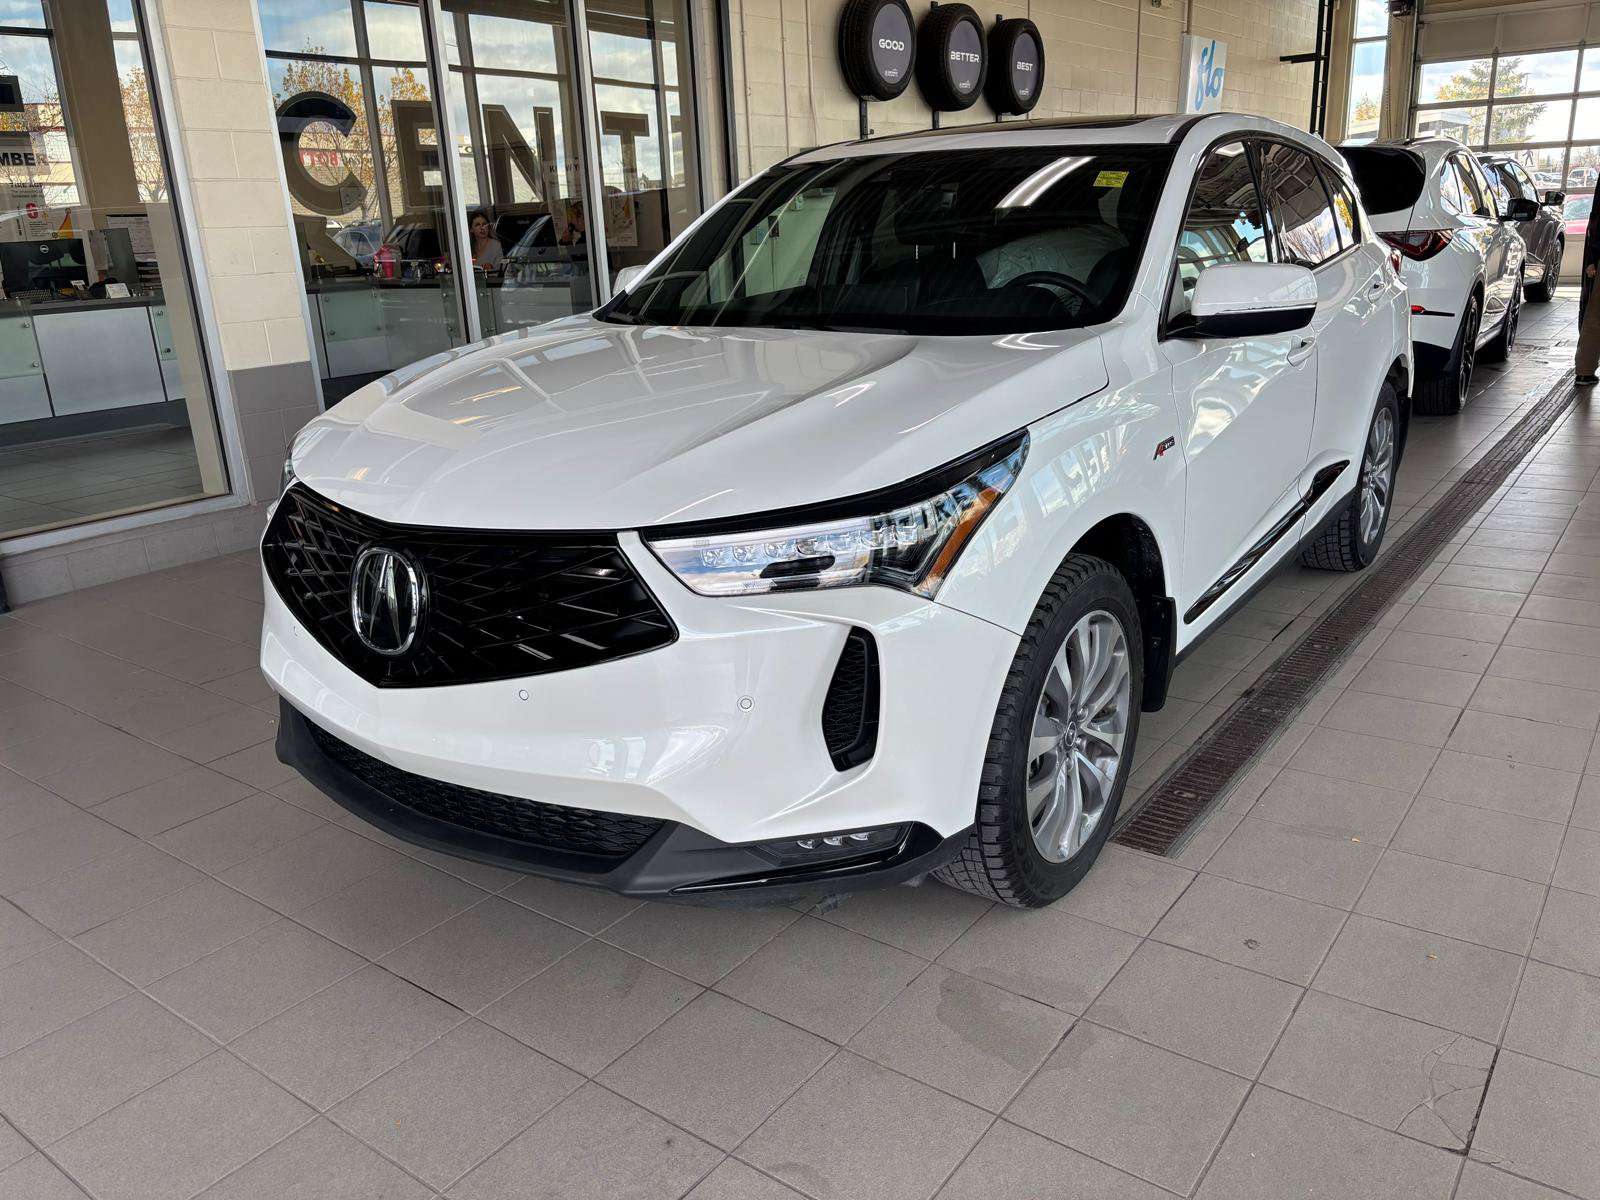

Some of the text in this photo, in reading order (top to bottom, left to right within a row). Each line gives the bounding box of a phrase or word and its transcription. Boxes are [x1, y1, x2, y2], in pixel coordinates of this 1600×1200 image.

[879, 38, 904, 51] GOOD
[951, 51, 980, 63] BETTER
[1017, 61, 1033, 71] BEST
